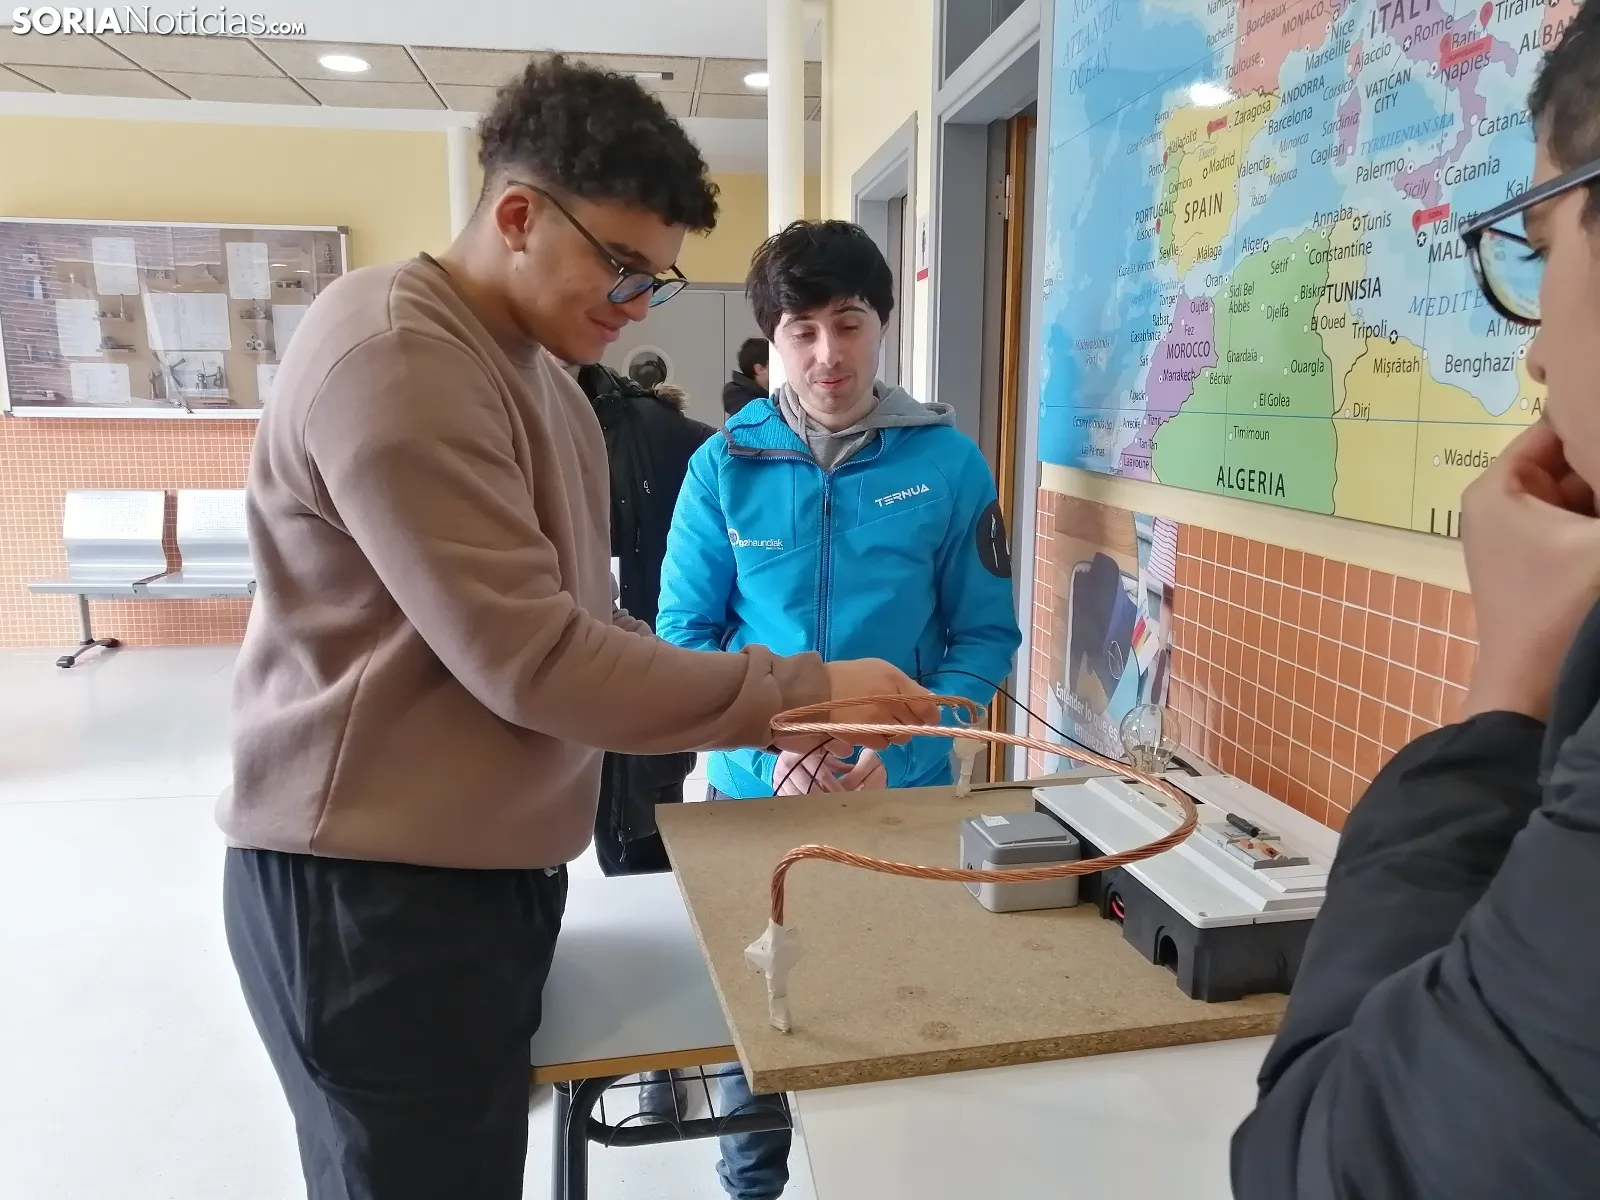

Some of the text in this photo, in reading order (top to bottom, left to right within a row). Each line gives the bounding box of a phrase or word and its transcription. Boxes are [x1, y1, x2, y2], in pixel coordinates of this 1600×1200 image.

[1227, 5, 1235, 19] La
[1246, 2, 1286, 36] Bordeaux
[1282, 2, 1325, 37] MONACO
[1062, 0, 1123, 66] ATLANTIC
[1206, 22, 1235, 48] Rochelle
[1331, 18, 1355, 42] Nice
[1412, 14, 1454, 46] Rome
[1451, 24, 1478, 49] Bari
[1519, 16, 1573, 55] ALBA
[1069, 41, 1112, 95] OCEAN
[1224, 52, 1261, 80] Toulouse
[1304, 39, 1351, 73] Marseille
[1354, 42, 1392, 72] Ajaccio
[1440, 50, 1491, 84] Naples
[1280, 75, 1325, 107] ANDORRA
[1322, 79, 1354, 101] Corsica
[1365, 67, 1412, 99] VATICAN
[1233, 99, 1271, 127] Zaragosa
[1374, 91, 1399, 114] CITY
[1268, 106, 1313, 135] Barcelona
[1321, 111, 1359, 137] Sardinia
[1478, 108, 1530, 137] Catanz
[1279, 132, 1310, 154] Minorca
[1360, 112, 1456, 156] TYRRHENIAN SEA
[1209, 149, 1236, 174] Madrid
[1310, 139, 1346, 166] Cagliari
[1237, 154, 1271, 179] Valencia
[1268, 168, 1298, 188] Majorca
[1355, 157, 1405, 184] Palermo
[1444, 155, 1501, 186] Catania
[1401, 178, 1431, 200] Sicily
[1505, 175, 1532, 200] Kal
[1134, 200, 1174, 225] PORTUGAL
[1184, 190, 1223, 224] SPAIN
[1250, 193, 1267, 208] Ibiza
[1312, 204, 1353, 229] Annaba
[1361, 210, 1392, 233] Tunis
[1196, 244, 1223, 261] Málaga
[1241, 237, 1264, 255] Alger
[1308, 239, 1374, 265] Constantine
[1428, 239, 1469, 264] MAL
[1270, 256, 1289, 275] Sétif
[1205, 273, 1223, 289] Oran
[1243, 281, 1255, 297] Bel
[1300, 283, 1326, 300] Biskra
[1325, 276, 1382, 304] TUNISIA
[1190, 300, 1209, 316] Oujda
[1266, 302, 1289, 322] Djelfa
[1408, 287, 1487, 317] MEDITE
[1184, 324, 1195, 336] Fez
[1310, 312, 1346, 331] El Oued
[1352, 319, 1388, 339] Tripoli
[1486, 317, 1500, 338] Al
[1130, 329, 1161, 343] Casablanca
[1166, 341, 1211, 359] MOROCCO
[1162, 367, 1196, 382] Marrakech
[1290, 358, 1325, 377] Ouargla
[1444, 352, 1516, 378] Benghazi
[1209, 372, 1232, 385] Béchar
[1259, 392, 1290, 407] El Golea
[1353, 402, 1371, 420] Dirj
[1233, 425, 1270, 440] Timimoun
[1216, 465, 1286, 498] ALGERIA
[874, 483, 930, 508] TERNUA
[1430, 507, 1462, 539] LI
[1056, 681, 1085, 716] Entender
[1085, 701, 1093, 723] lo
[1093, 713, 1107, 734] que
[1108, 723, 1119, 742] es
